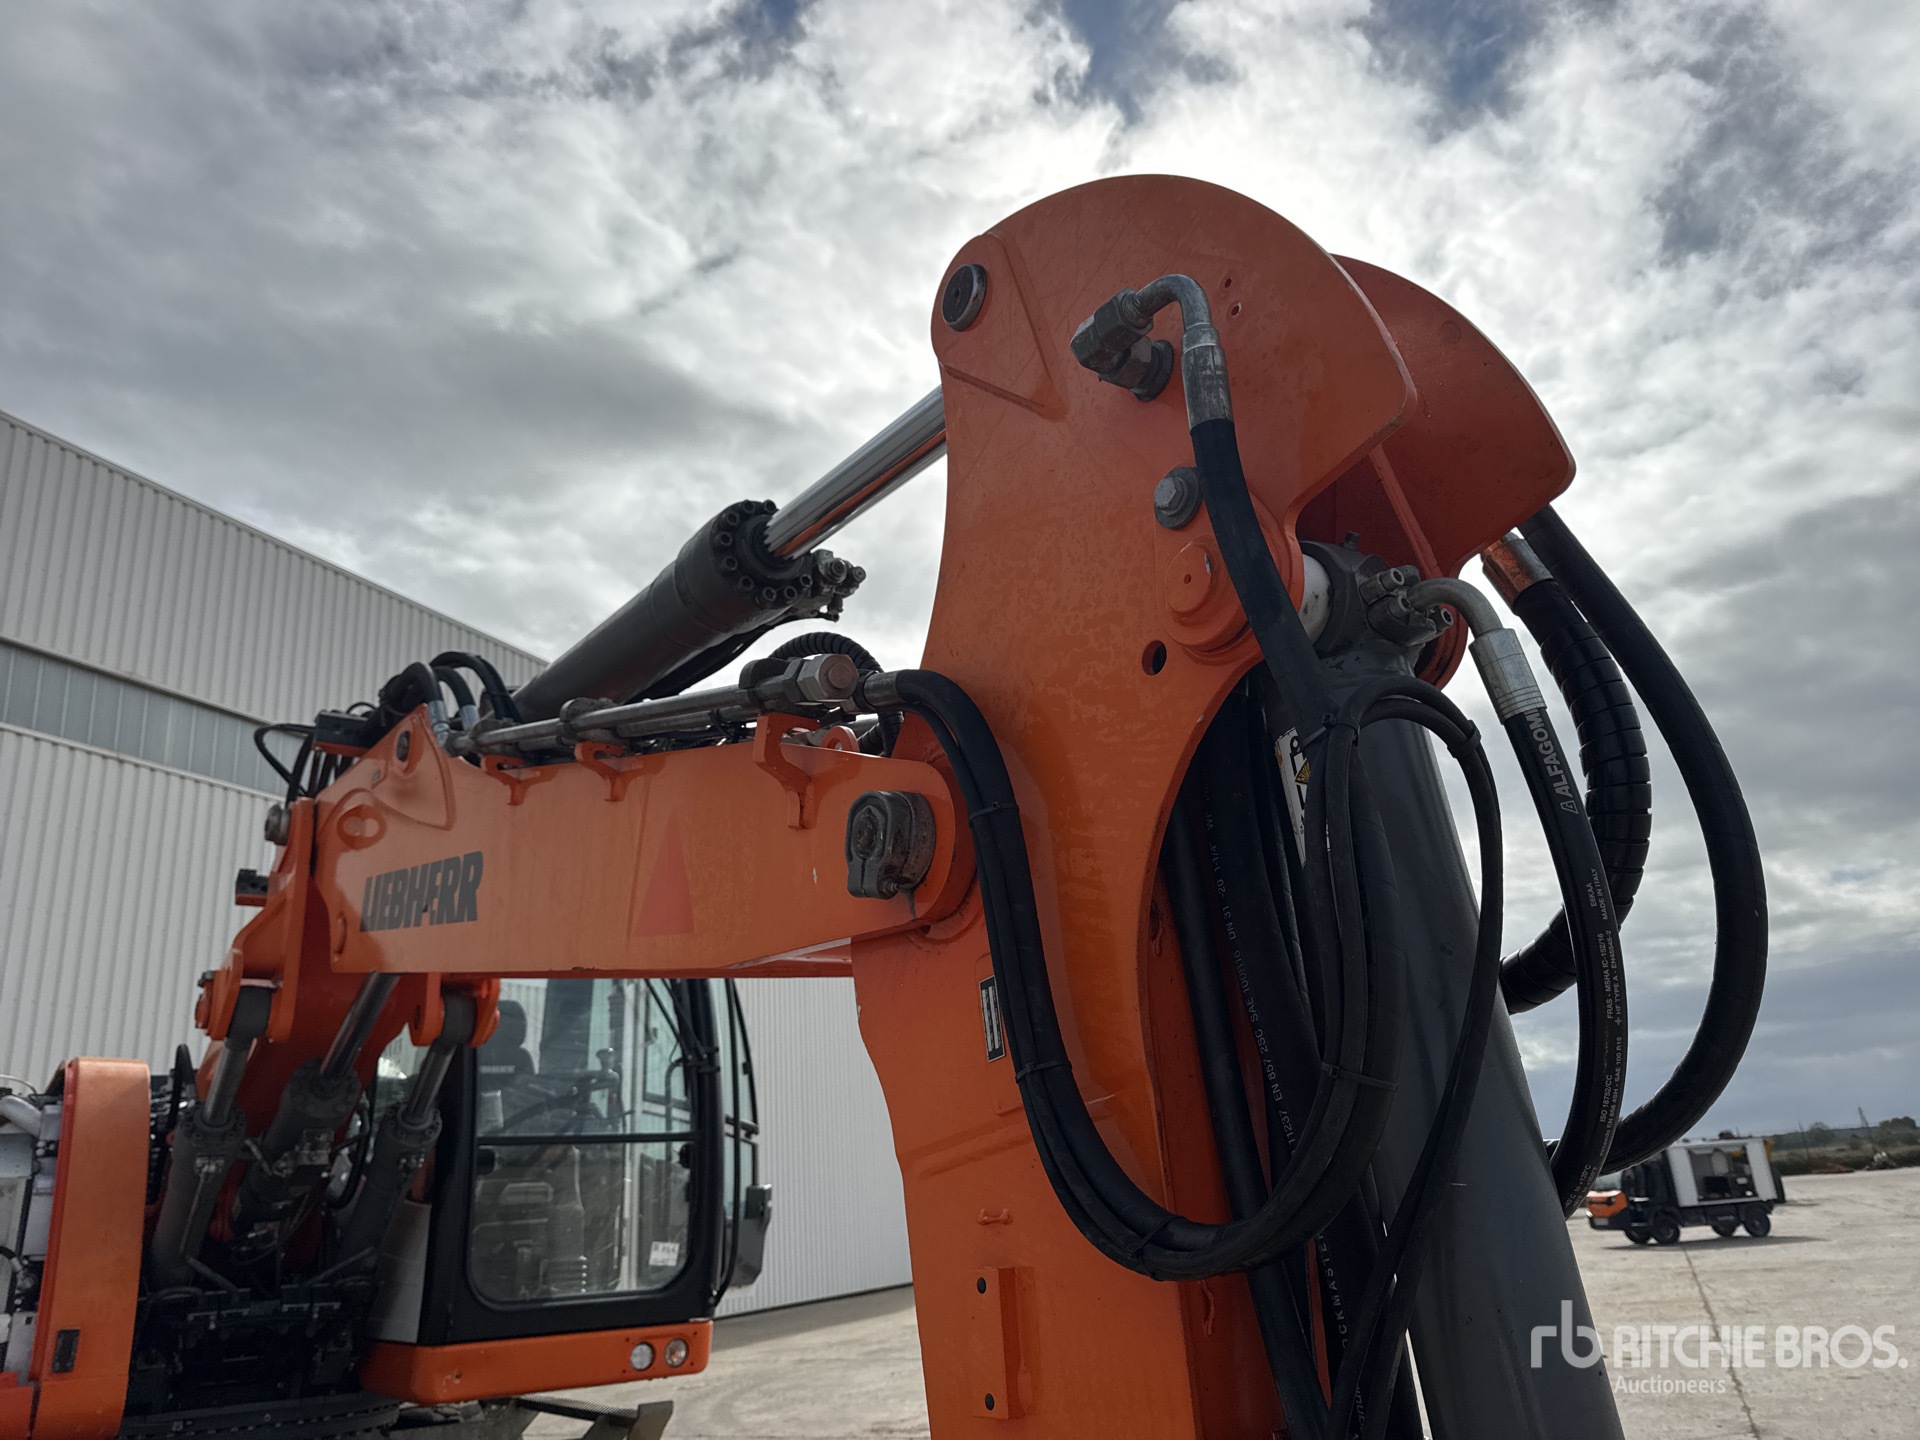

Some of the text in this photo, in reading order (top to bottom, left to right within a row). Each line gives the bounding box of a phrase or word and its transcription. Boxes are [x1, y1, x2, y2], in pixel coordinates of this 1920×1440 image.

[360, 851, 484, 933] LIEBHERR
[1590, 867, 1609, 920] MADE IN ITALY
[1222, 905, 1232, 919] 31
[1225, 922, 1237, 940] DN
[1232, 949, 1251, 994] 100R16
[1603, 969, 1612, 992] MSHA
[1612, 982, 1621, 1003] TYPE
[1246, 997, 1260, 1022] SAE
[1606, 998, 1614, 1019] FRAS
[1615, 1004, 1622, 1015] HF
[1254, 1028, 1270, 1054] 2SC
[1263, 1058, 1277, 1081] 857
[1271, 1083, 1283, 1102] EN
[1602, 1074, 1613, 1108] 18752/CC
[1606, 1118, 1614, 1128] EN
[1614, 1066, 1622, 1082] SAE
[1599, 1109, 1608, 1122] ISO
[1279, 1110, 1297, 1145] 11237
